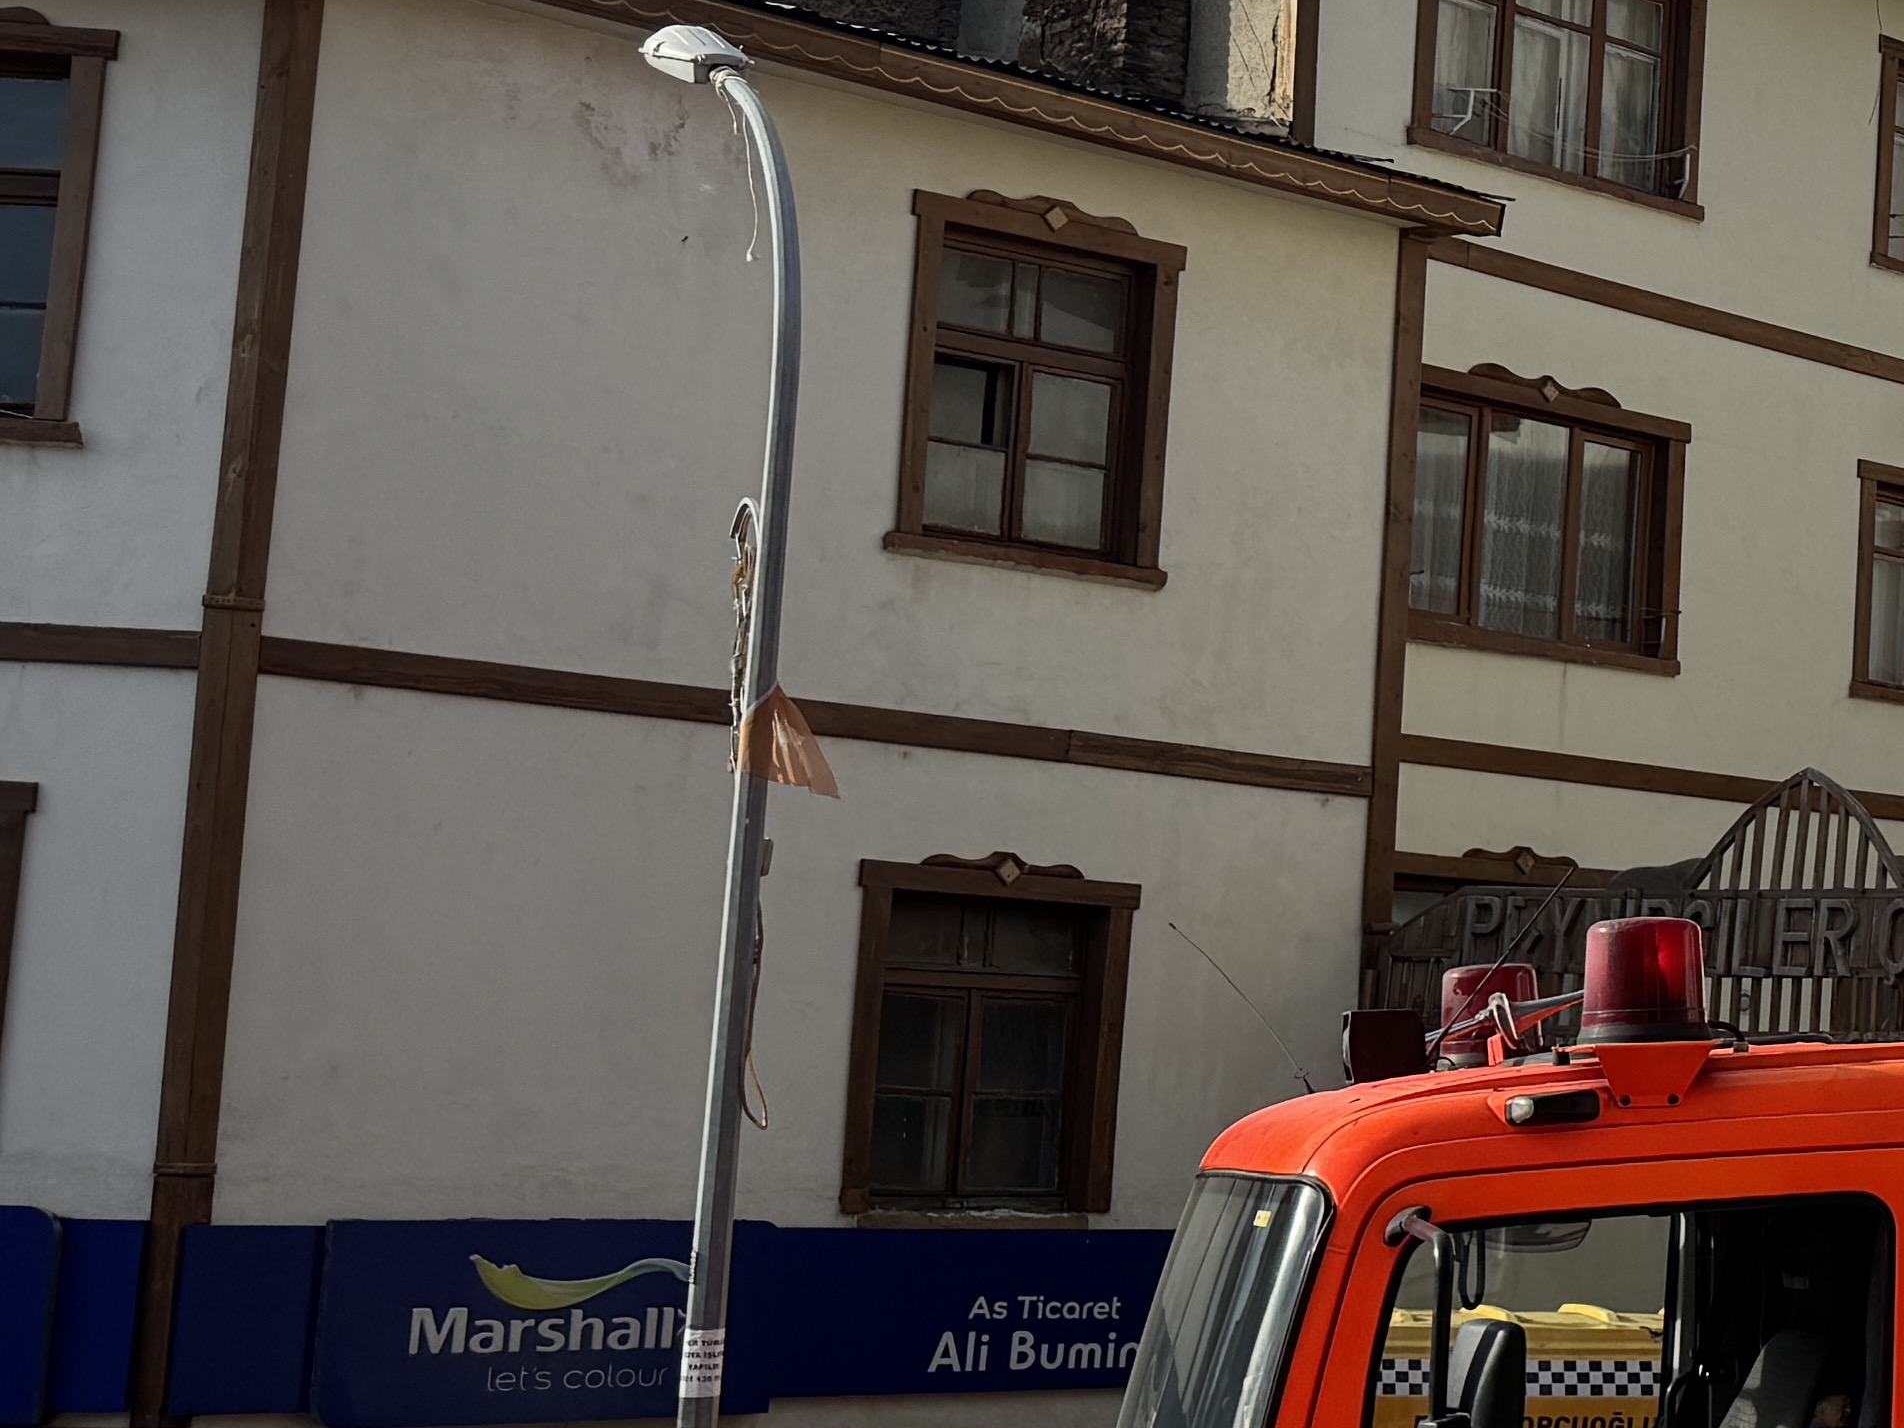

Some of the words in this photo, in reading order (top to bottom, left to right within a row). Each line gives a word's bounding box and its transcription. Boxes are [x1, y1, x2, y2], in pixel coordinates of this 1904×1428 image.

[968, 1296, 1009, 1322] As
[1014, 1294, 1122, 1322] Ticaret
[407, 1306, 674, 1359] Marshall
[926, 1329, 989, 1374] Ali
[486, 1364, 555, 1393] let's
[561, 1363, 668, 1391] colour
